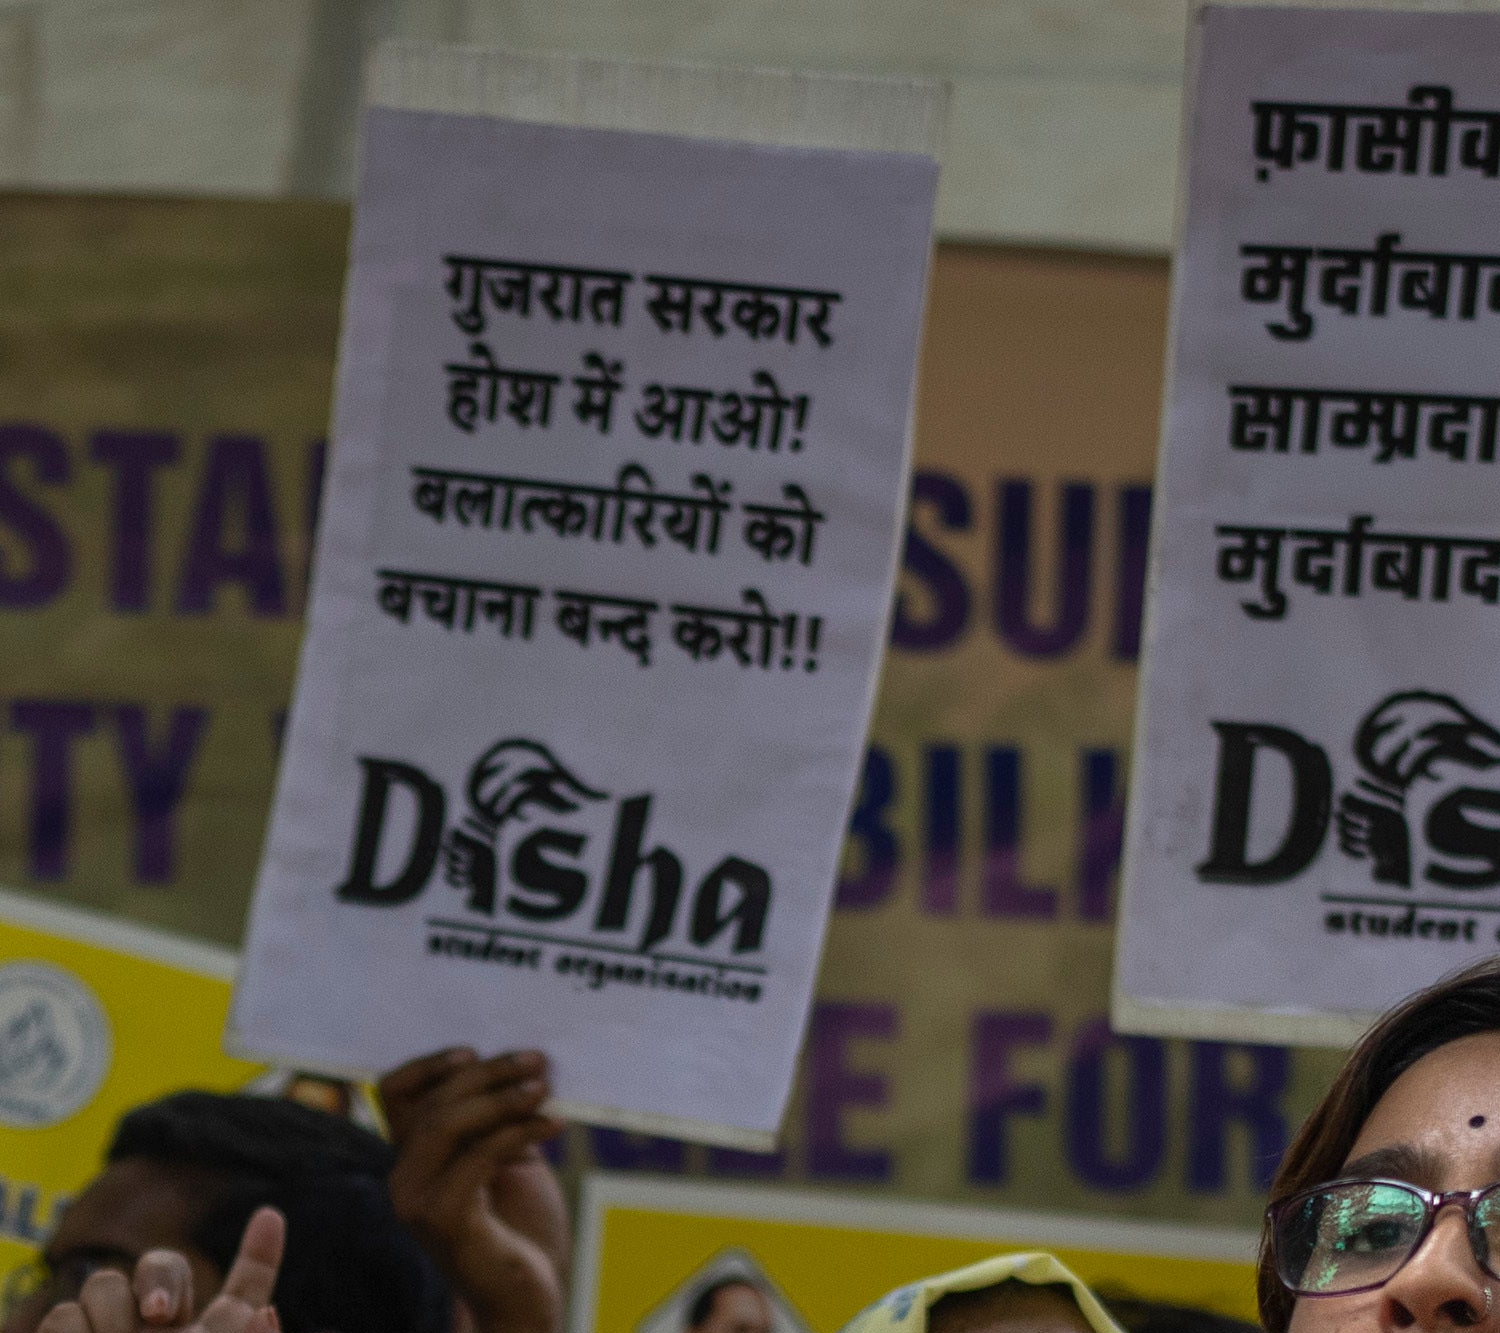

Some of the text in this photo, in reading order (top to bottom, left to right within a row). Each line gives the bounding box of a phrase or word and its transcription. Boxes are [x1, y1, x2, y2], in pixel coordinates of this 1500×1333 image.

[442, 255, 841, 347] गुजरात सरकार
[445, 344, 809, 452] होश में आओ!
[411, 464, 824, 564] बलात्कारियों को
[377, 567, 822, 672] बचाना बन्द करो!!
[334, 738, 772, 955] Disha
[428, 931, 762, 1003] student organisation
[1323, 906, 1477, 943] student
[969, 1008, 1293, 1197] FOR
